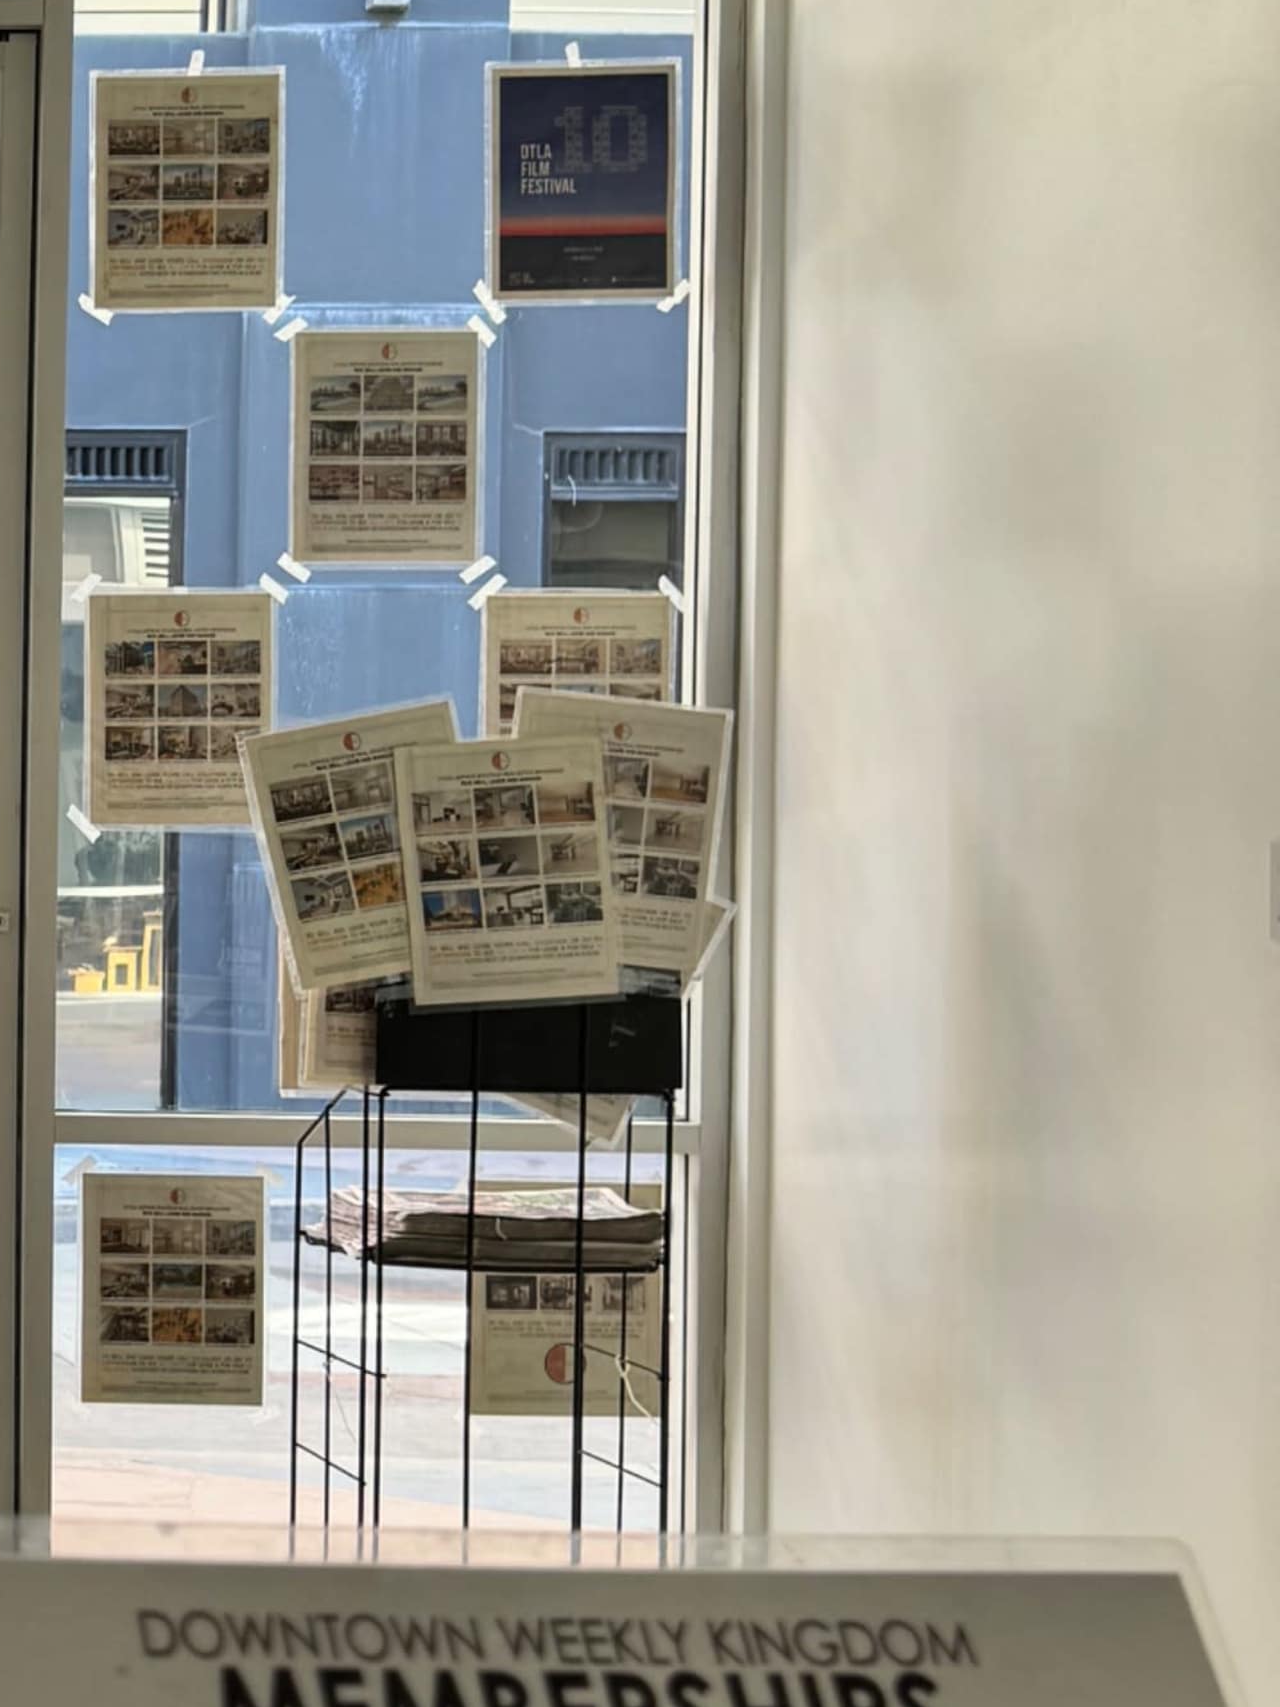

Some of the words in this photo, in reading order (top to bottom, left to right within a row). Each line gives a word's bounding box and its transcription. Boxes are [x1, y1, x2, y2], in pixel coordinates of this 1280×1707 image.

[554, 105, 647, 172] 10
[520, 143, 552, 160] DTLA
[520, 161, 551, 177] FILM
[520, 178, 577, 194] FESTIVAL
[137, 1609, 486, 1663] DOWNTOWN
[496, 1616, 689, 1667] WEEKLY
[708, 1619, 980, 1668] KINGDOM
